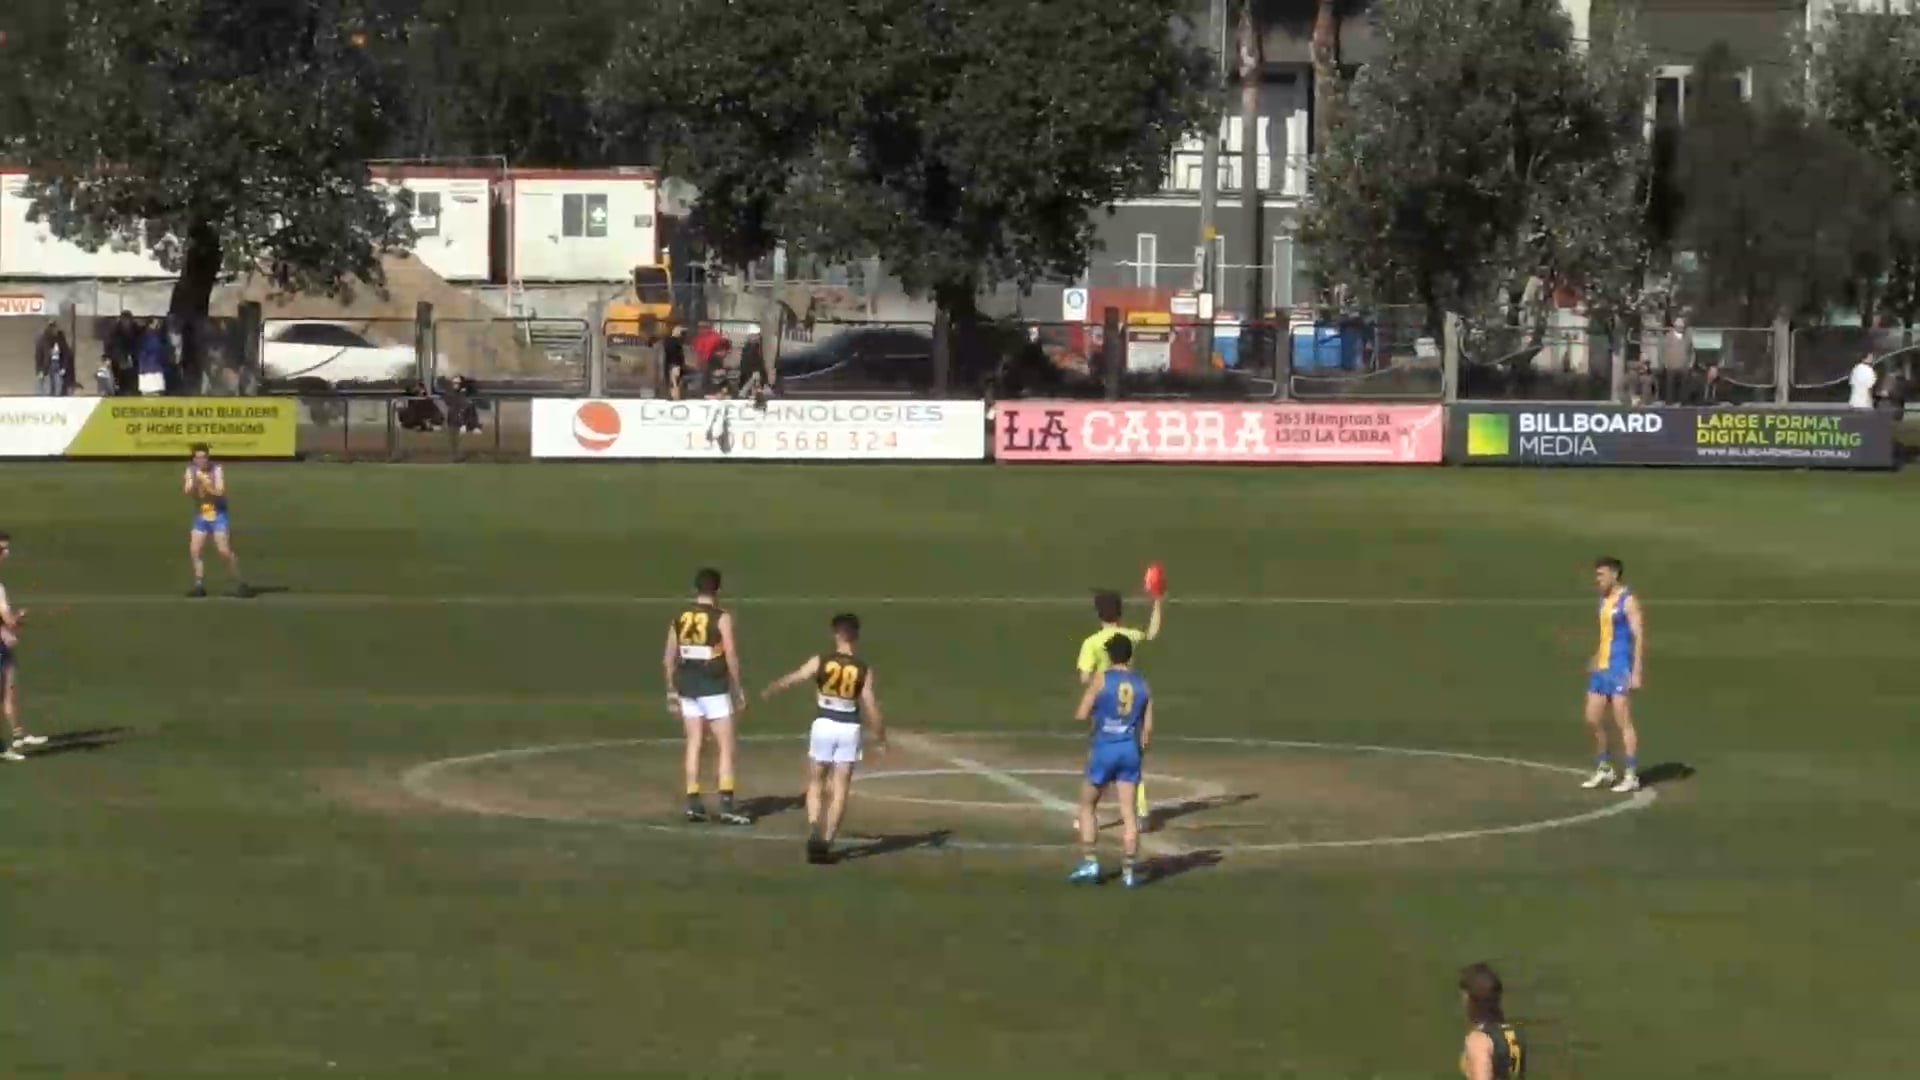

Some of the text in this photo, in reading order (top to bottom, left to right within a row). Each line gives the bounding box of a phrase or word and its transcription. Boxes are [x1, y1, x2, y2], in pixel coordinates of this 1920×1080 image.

[112, 407, 278, 418] DESIGNERS AND BUILDERS
[704, 405, 943, 422] TECHNOLOGIES
[1305, 412, 1373, 427] Hampton
[1377, 413, 1391, 425] St
[126, 424, 264, 434] OF HOME EXTENSIONS
[1519, 413, 1662, 432] BILLBOARD
[1697, 414, 1841, 430] LARGE FORMAT
[776, 431, 828, 449] 568
[848, 431, 898, 449] 324
[1003, 410, 1269, 453] LA CABRA
[1315, 429, 1334, 442] LA
[1697, 430, 1862, 446] DIGITAL PRINTING
[1519, 435, 1597, 456] MEDIA
[680, 611, 708, 644] 23
[822, 661, 858, 697] 28
[1118, 682, 1133, 715] 9
